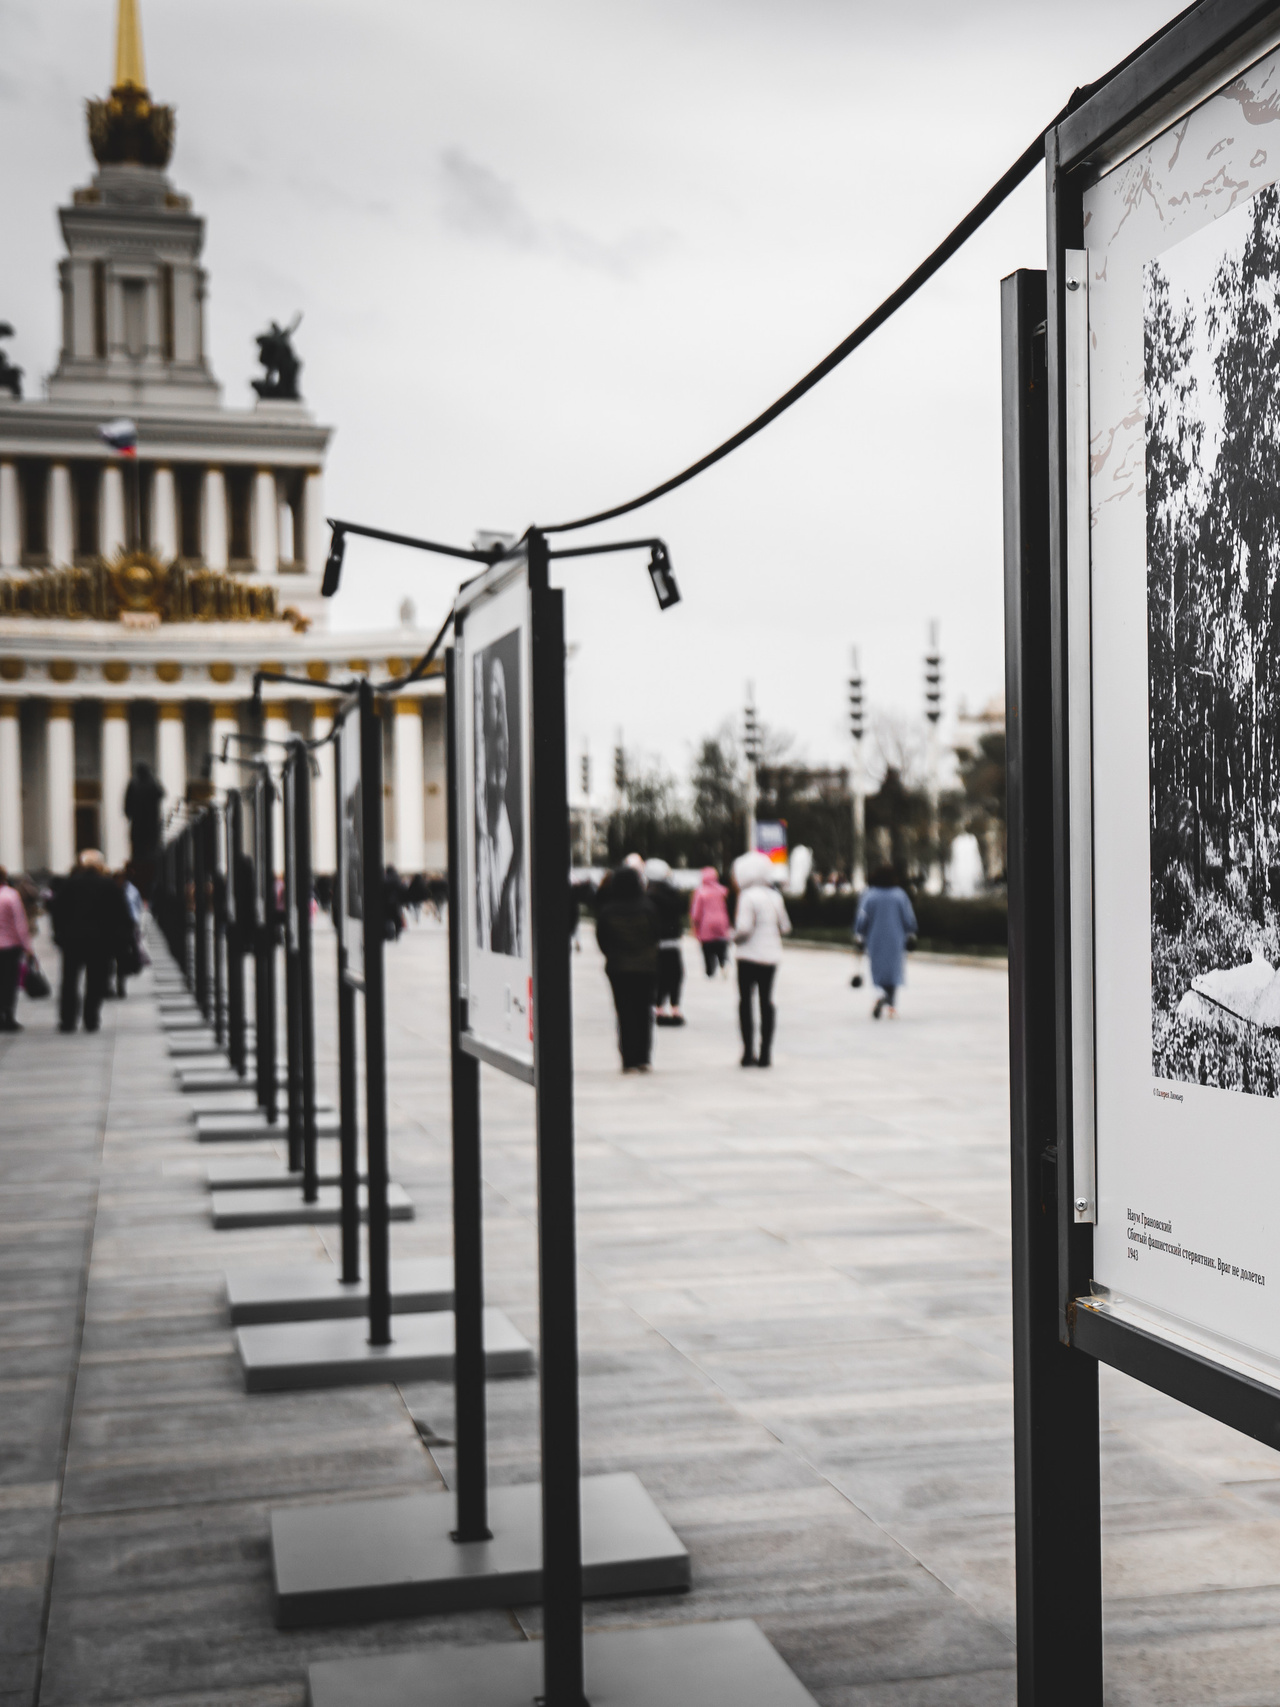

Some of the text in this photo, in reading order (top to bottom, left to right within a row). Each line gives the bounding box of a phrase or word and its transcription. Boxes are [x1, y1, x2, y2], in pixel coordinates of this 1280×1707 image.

[1127, 1207, 1172, 1233] Наум Грановский
[1127, 1246, 1139, 1261] 1943
[1127, 1227, 1265, 1286] Сбитый фашистский стервятник. Враг не долетел
